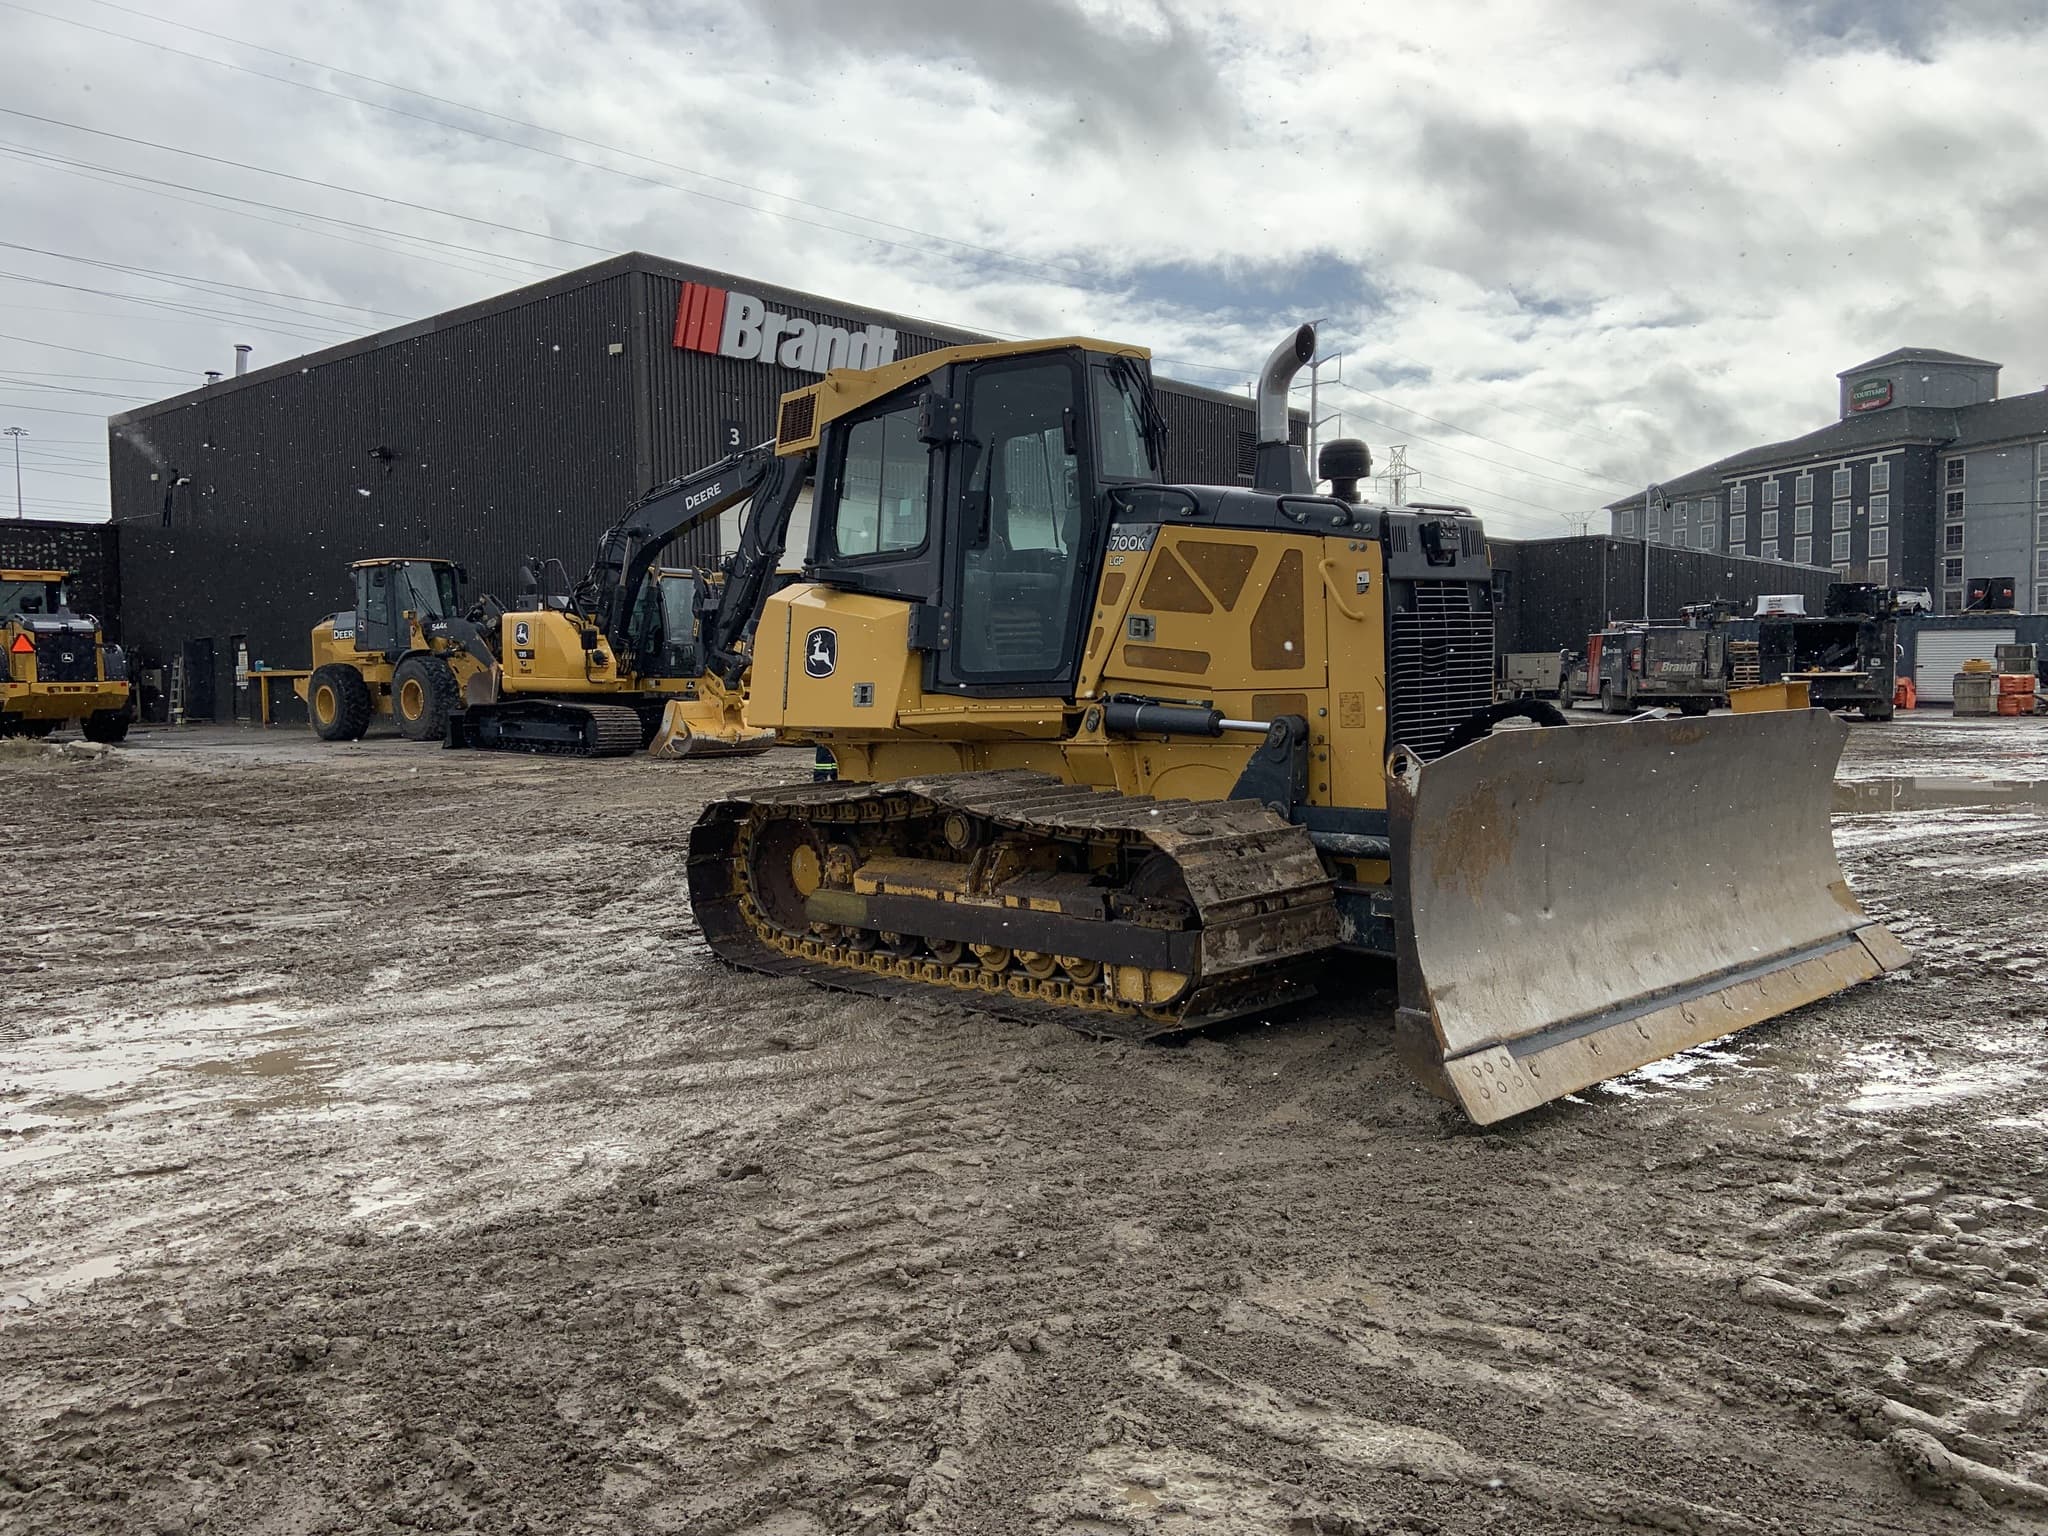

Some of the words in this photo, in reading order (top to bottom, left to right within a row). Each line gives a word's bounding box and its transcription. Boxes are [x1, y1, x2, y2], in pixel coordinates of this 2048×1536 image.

[718, 291, 898, 373] Brandt
[729, 428, 740, 446] 3
[685, 483, 721, 510] DEERE
[1111, 535, 1146, 551] 700K
[1109, 556, 1124, 566] LGP
[333, 630, 354, 640] DEER
[1661, 661, 1697, 672] Brandt
